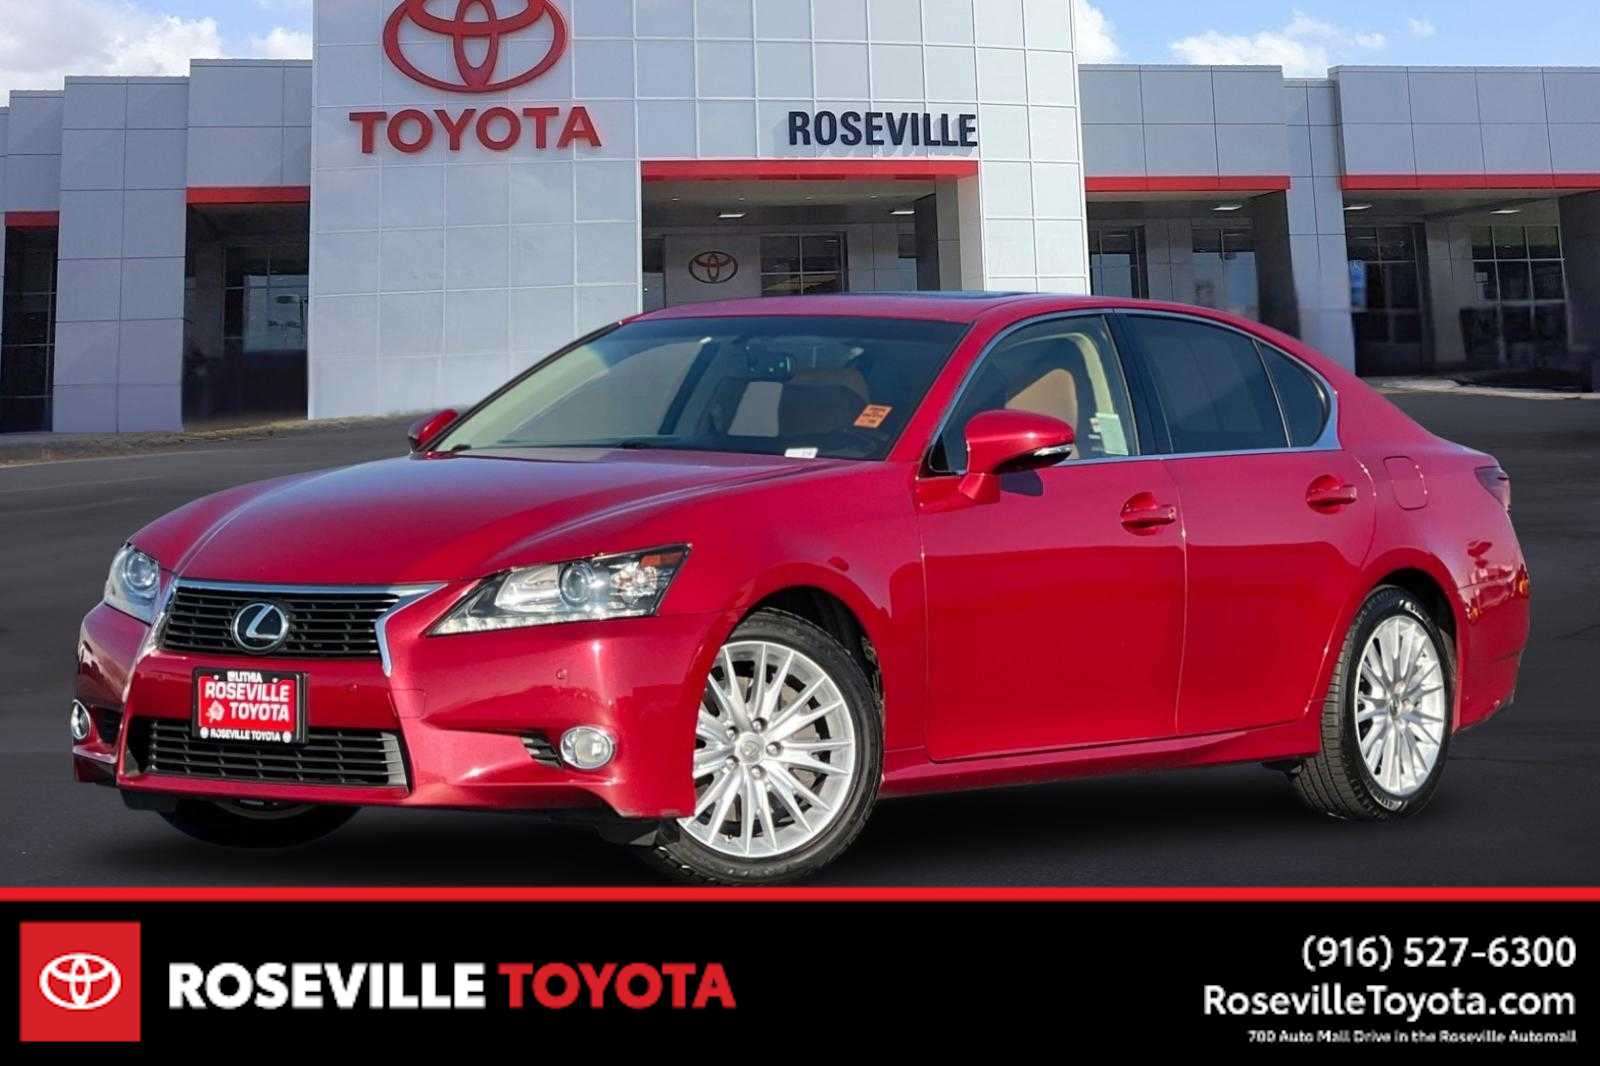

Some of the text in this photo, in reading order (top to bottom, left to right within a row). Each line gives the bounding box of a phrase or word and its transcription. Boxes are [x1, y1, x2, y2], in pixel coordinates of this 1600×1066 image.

[350, 106, 602, 154] TOYOTA
[788, 111, 978, 147] ROSEVILLE
[205, 681, 290, 702] ROSEVILLE
[229, 702, 290, 722] TOYOTA
[210, 729, 281, 741] ROSEVILLE TOYOTA
